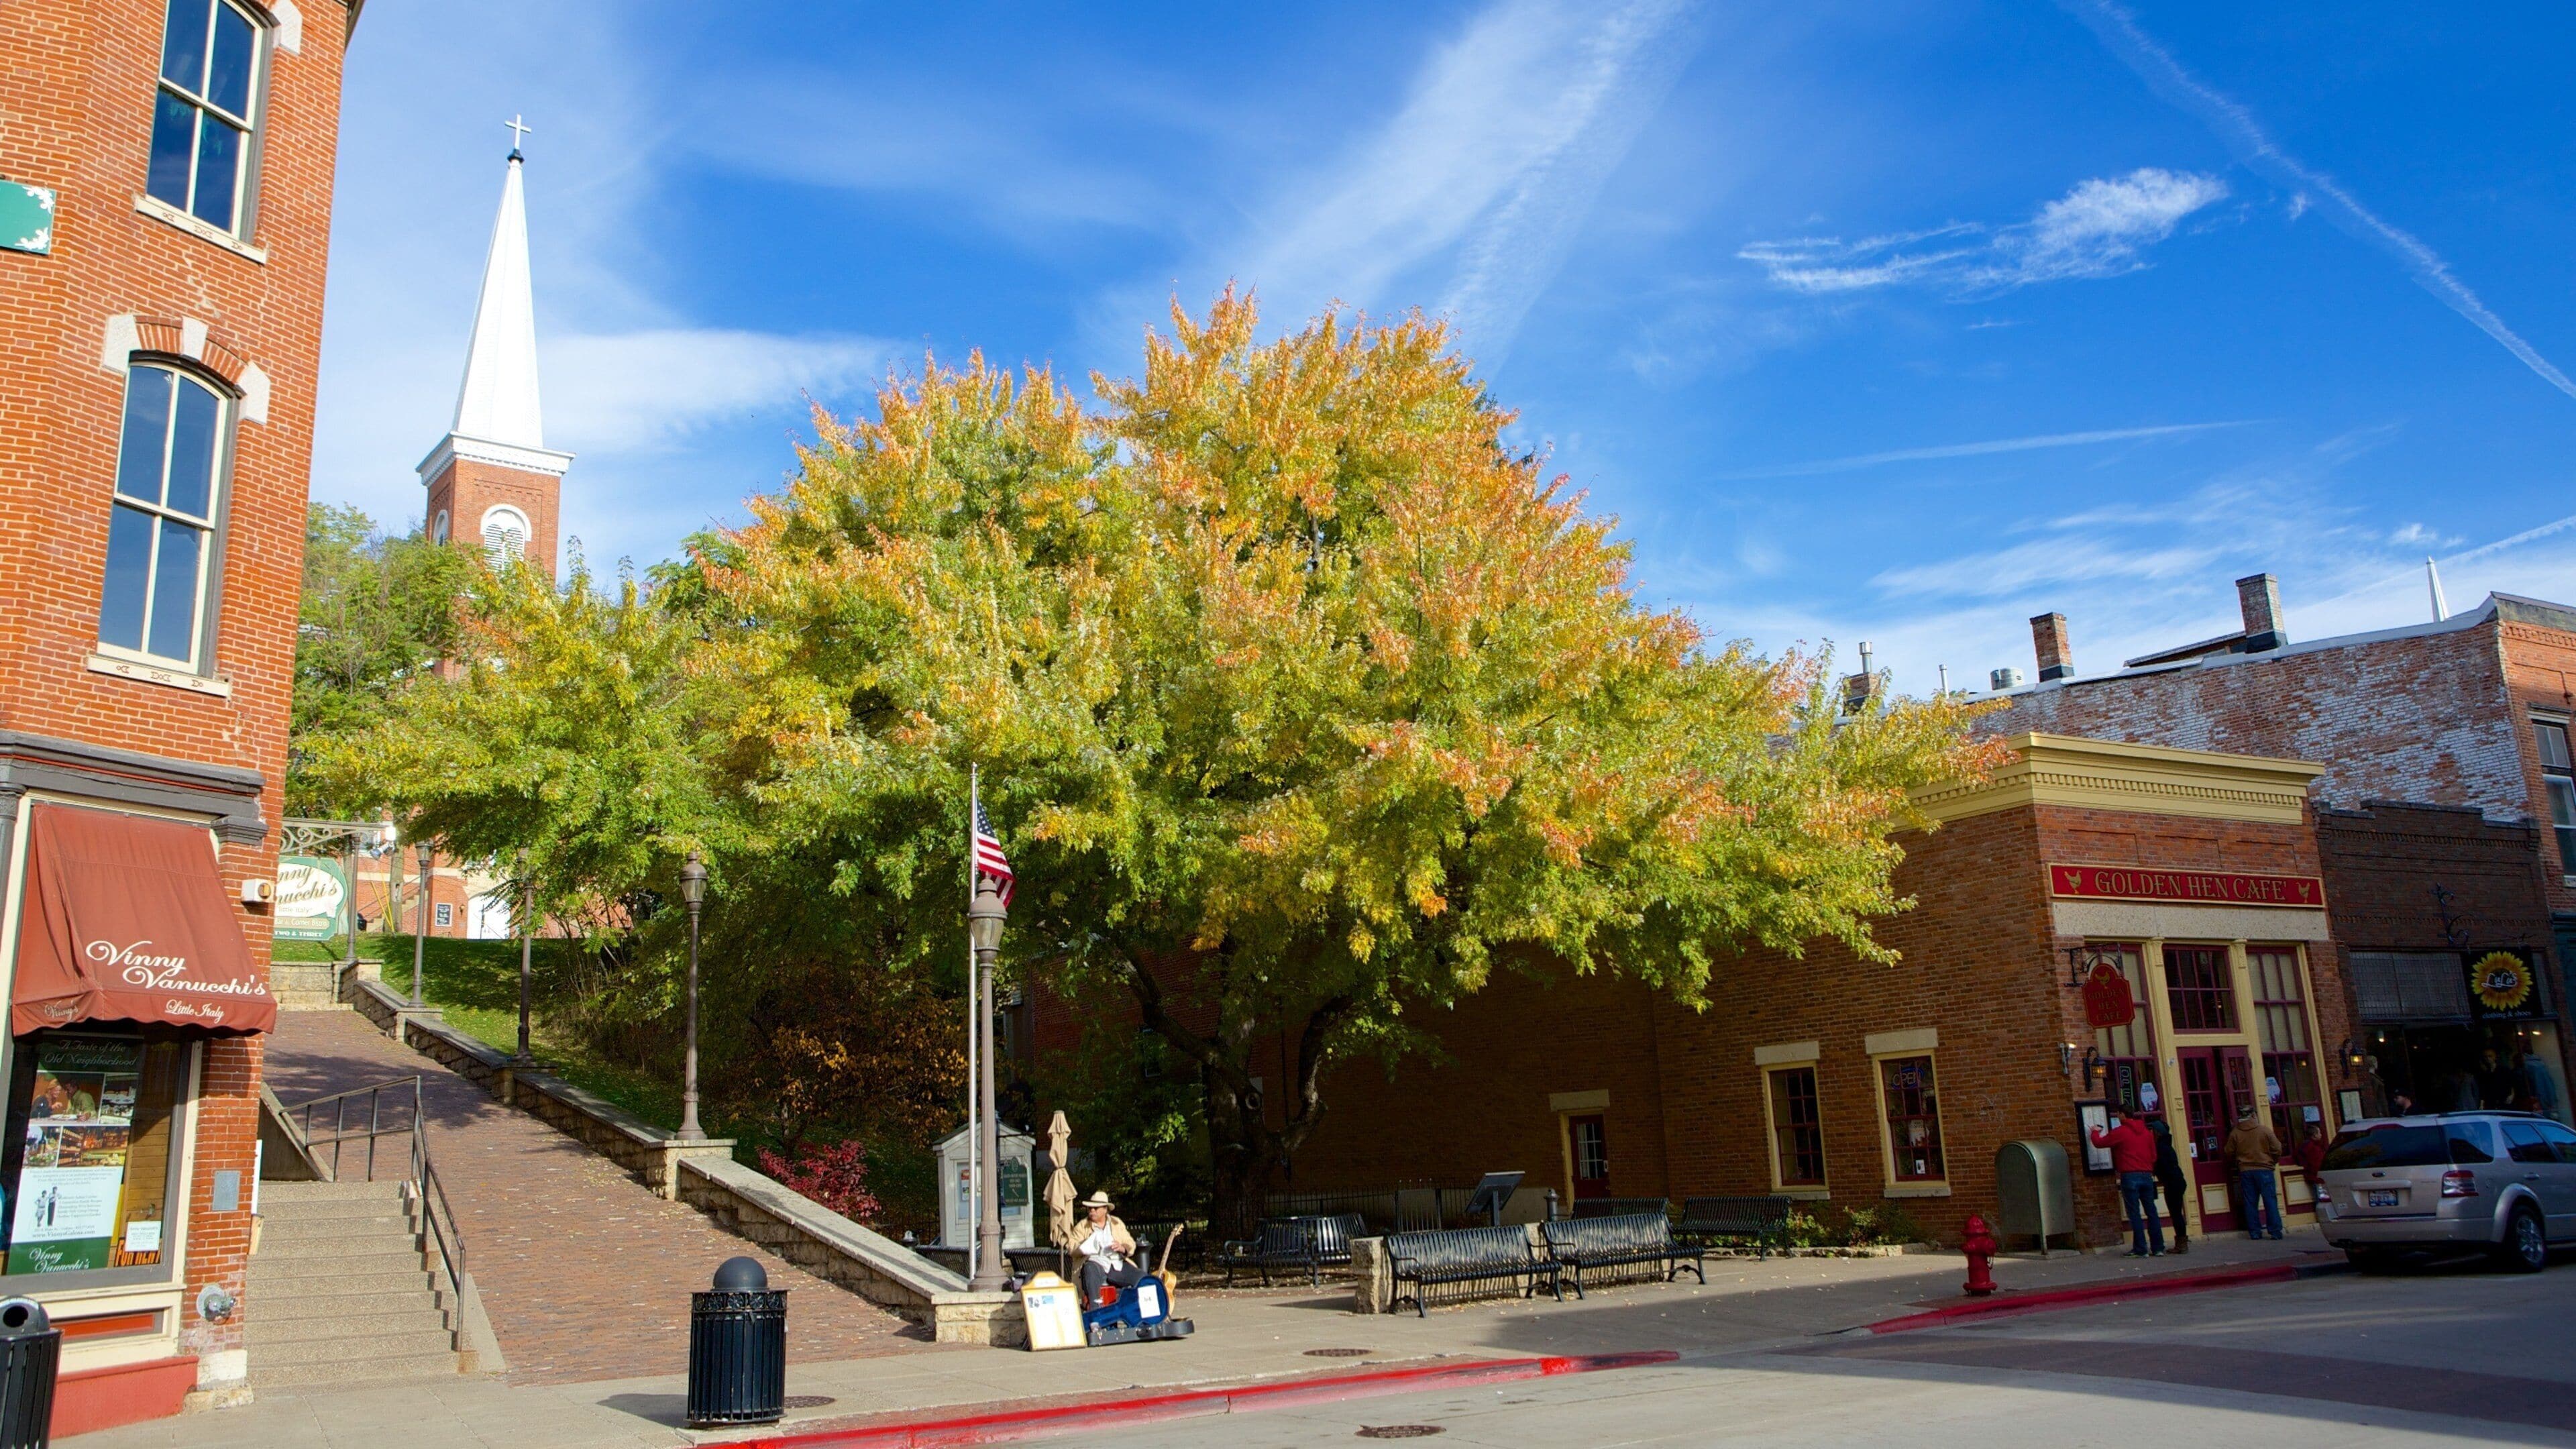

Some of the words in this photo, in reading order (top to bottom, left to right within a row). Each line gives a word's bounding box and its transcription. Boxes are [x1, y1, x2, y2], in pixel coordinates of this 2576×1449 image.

[278, 867, 313, 889] nny
[2094, 871, 2181, 896] GOLDEN
[2187, 875, 2229, 898] HEN
[278, 875, 337, 905] nucchi's
[291, 918, 311, 926] Corner
[86, 941, 186, 977] Vinny
[122, 966, 266, 996] Vanucchi's
[44, 1000, 78, 1021] Vinny's
[165, 999, 195, 1016] Little
[195, 1004, 225, 1024] Italy
[72, 1040, 99, 1051] Taste
[99, 1041, 111, 1053] of
[111, 1042, 126, 1052] the
[45, 1053, 64, 1063] Old
[67, 1053, 138, 1067] Neighborhood
[30, 1245, 63, 1264] Vinny
